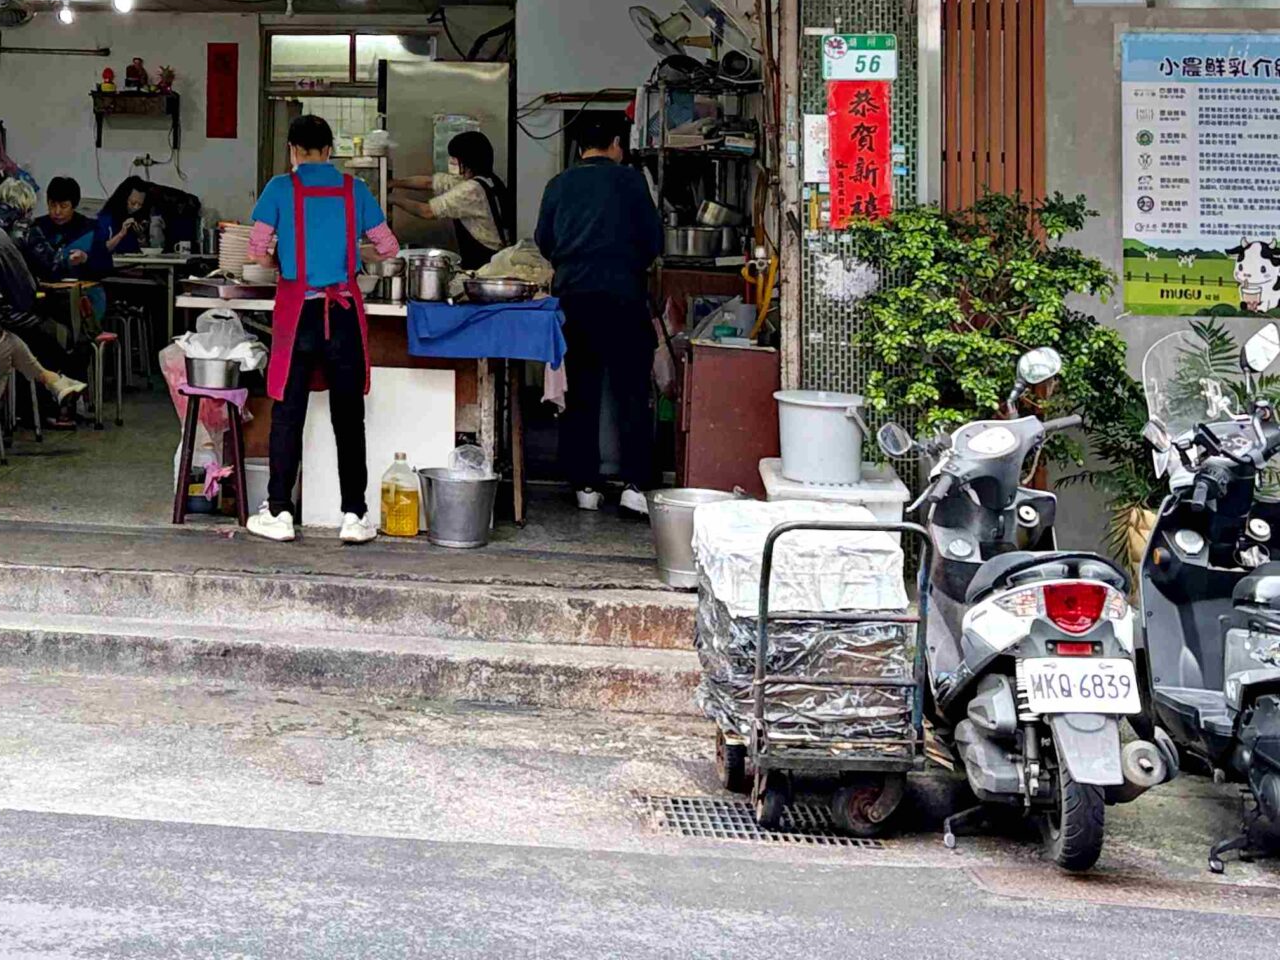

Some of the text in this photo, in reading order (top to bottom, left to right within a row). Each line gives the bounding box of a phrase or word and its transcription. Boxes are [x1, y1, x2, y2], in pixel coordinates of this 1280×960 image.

[854, 54, 882, 73] 56
[1159, 56, 1280, 77] 小農鮮乳介
[848, 88, 881, 222] 恭賀新禧
